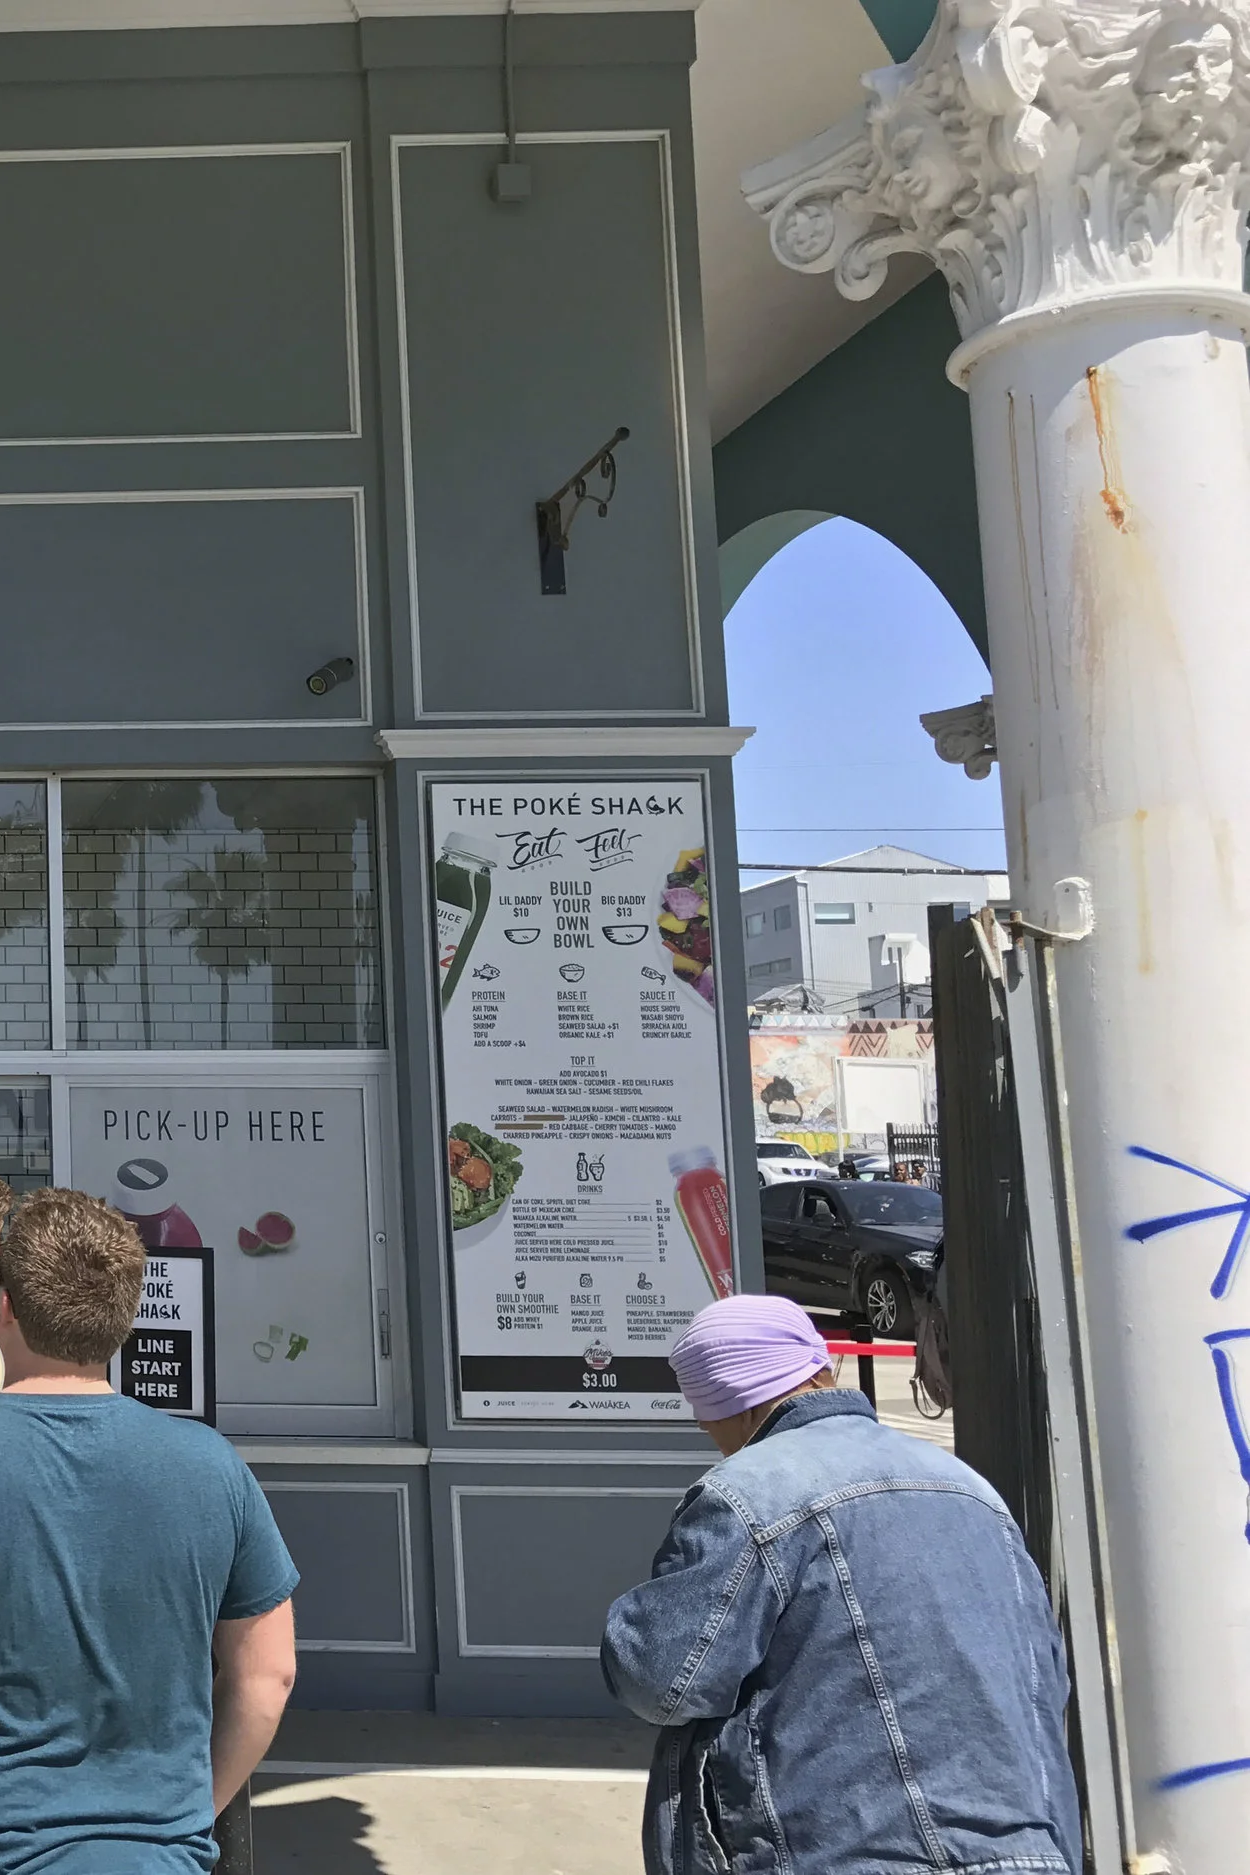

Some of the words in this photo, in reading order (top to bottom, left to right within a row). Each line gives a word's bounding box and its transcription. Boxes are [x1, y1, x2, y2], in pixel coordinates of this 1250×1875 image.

[453, 798, 503, 816] THE
[513, 792, 581, 815] POKÉ
[591, 795, 684, 816] SHACK
[495, 827, 567, 865] Eat
[575, 828, 642, 859] Feel
[550, 881, 592, 896] BUILD
[499, 896, 512, 905] LIL
[514, 896, 542, 905] DADDY
[553, 899, 591, 913] YOUR
[601, 896, 615, 905] BIG
[618, 896, 646, 905] DADDY
[513, 908, 529, 917] $10
[616, 908, 632, 917] $13
[557, 916, 589, 931] OWN
[554, 934, 594, 948] BOWL
[472, 991, 505, 1000] PROTEIN
[557, 991, 577, 1000] BASE
[580, 991, 587, 1000] IT
[640, 991, 666, 1000] SAUCE
[669, 991, 675, 1000] IT
[570, 1056, 586, 1065] TOP
[587, 1056, 595, 1065] IT
[104, 1110, 229, 1141] PICK-UP
[248, 1110, 325, 1142] HERE
[578, 1185, 603, 1193] DRINKS
[144, 1262, 168, 1277] THE
[496, 1294, 520, 1303] BUILD
[522, 1294, 544, 1303] YOUR
[570, 1295, 591, 1304] BASE
[594, 1295, 600, 1304] IT
[626, 1295, 658, 1304] CHOOSE
[660, 1295, 665, 1304] 3
[497, 1304, 516, 1314] OWN
[518, 1304, 559, 1314] SMOOTHIE
[497, 1315, 512, 1331] $8
[138, 1339, 174, 1354] LINE
[131, 1360, 181, 1376] START
[582, 1372, 617, 1388] $3.00
[134, 1382, 178, 1398] HERE
